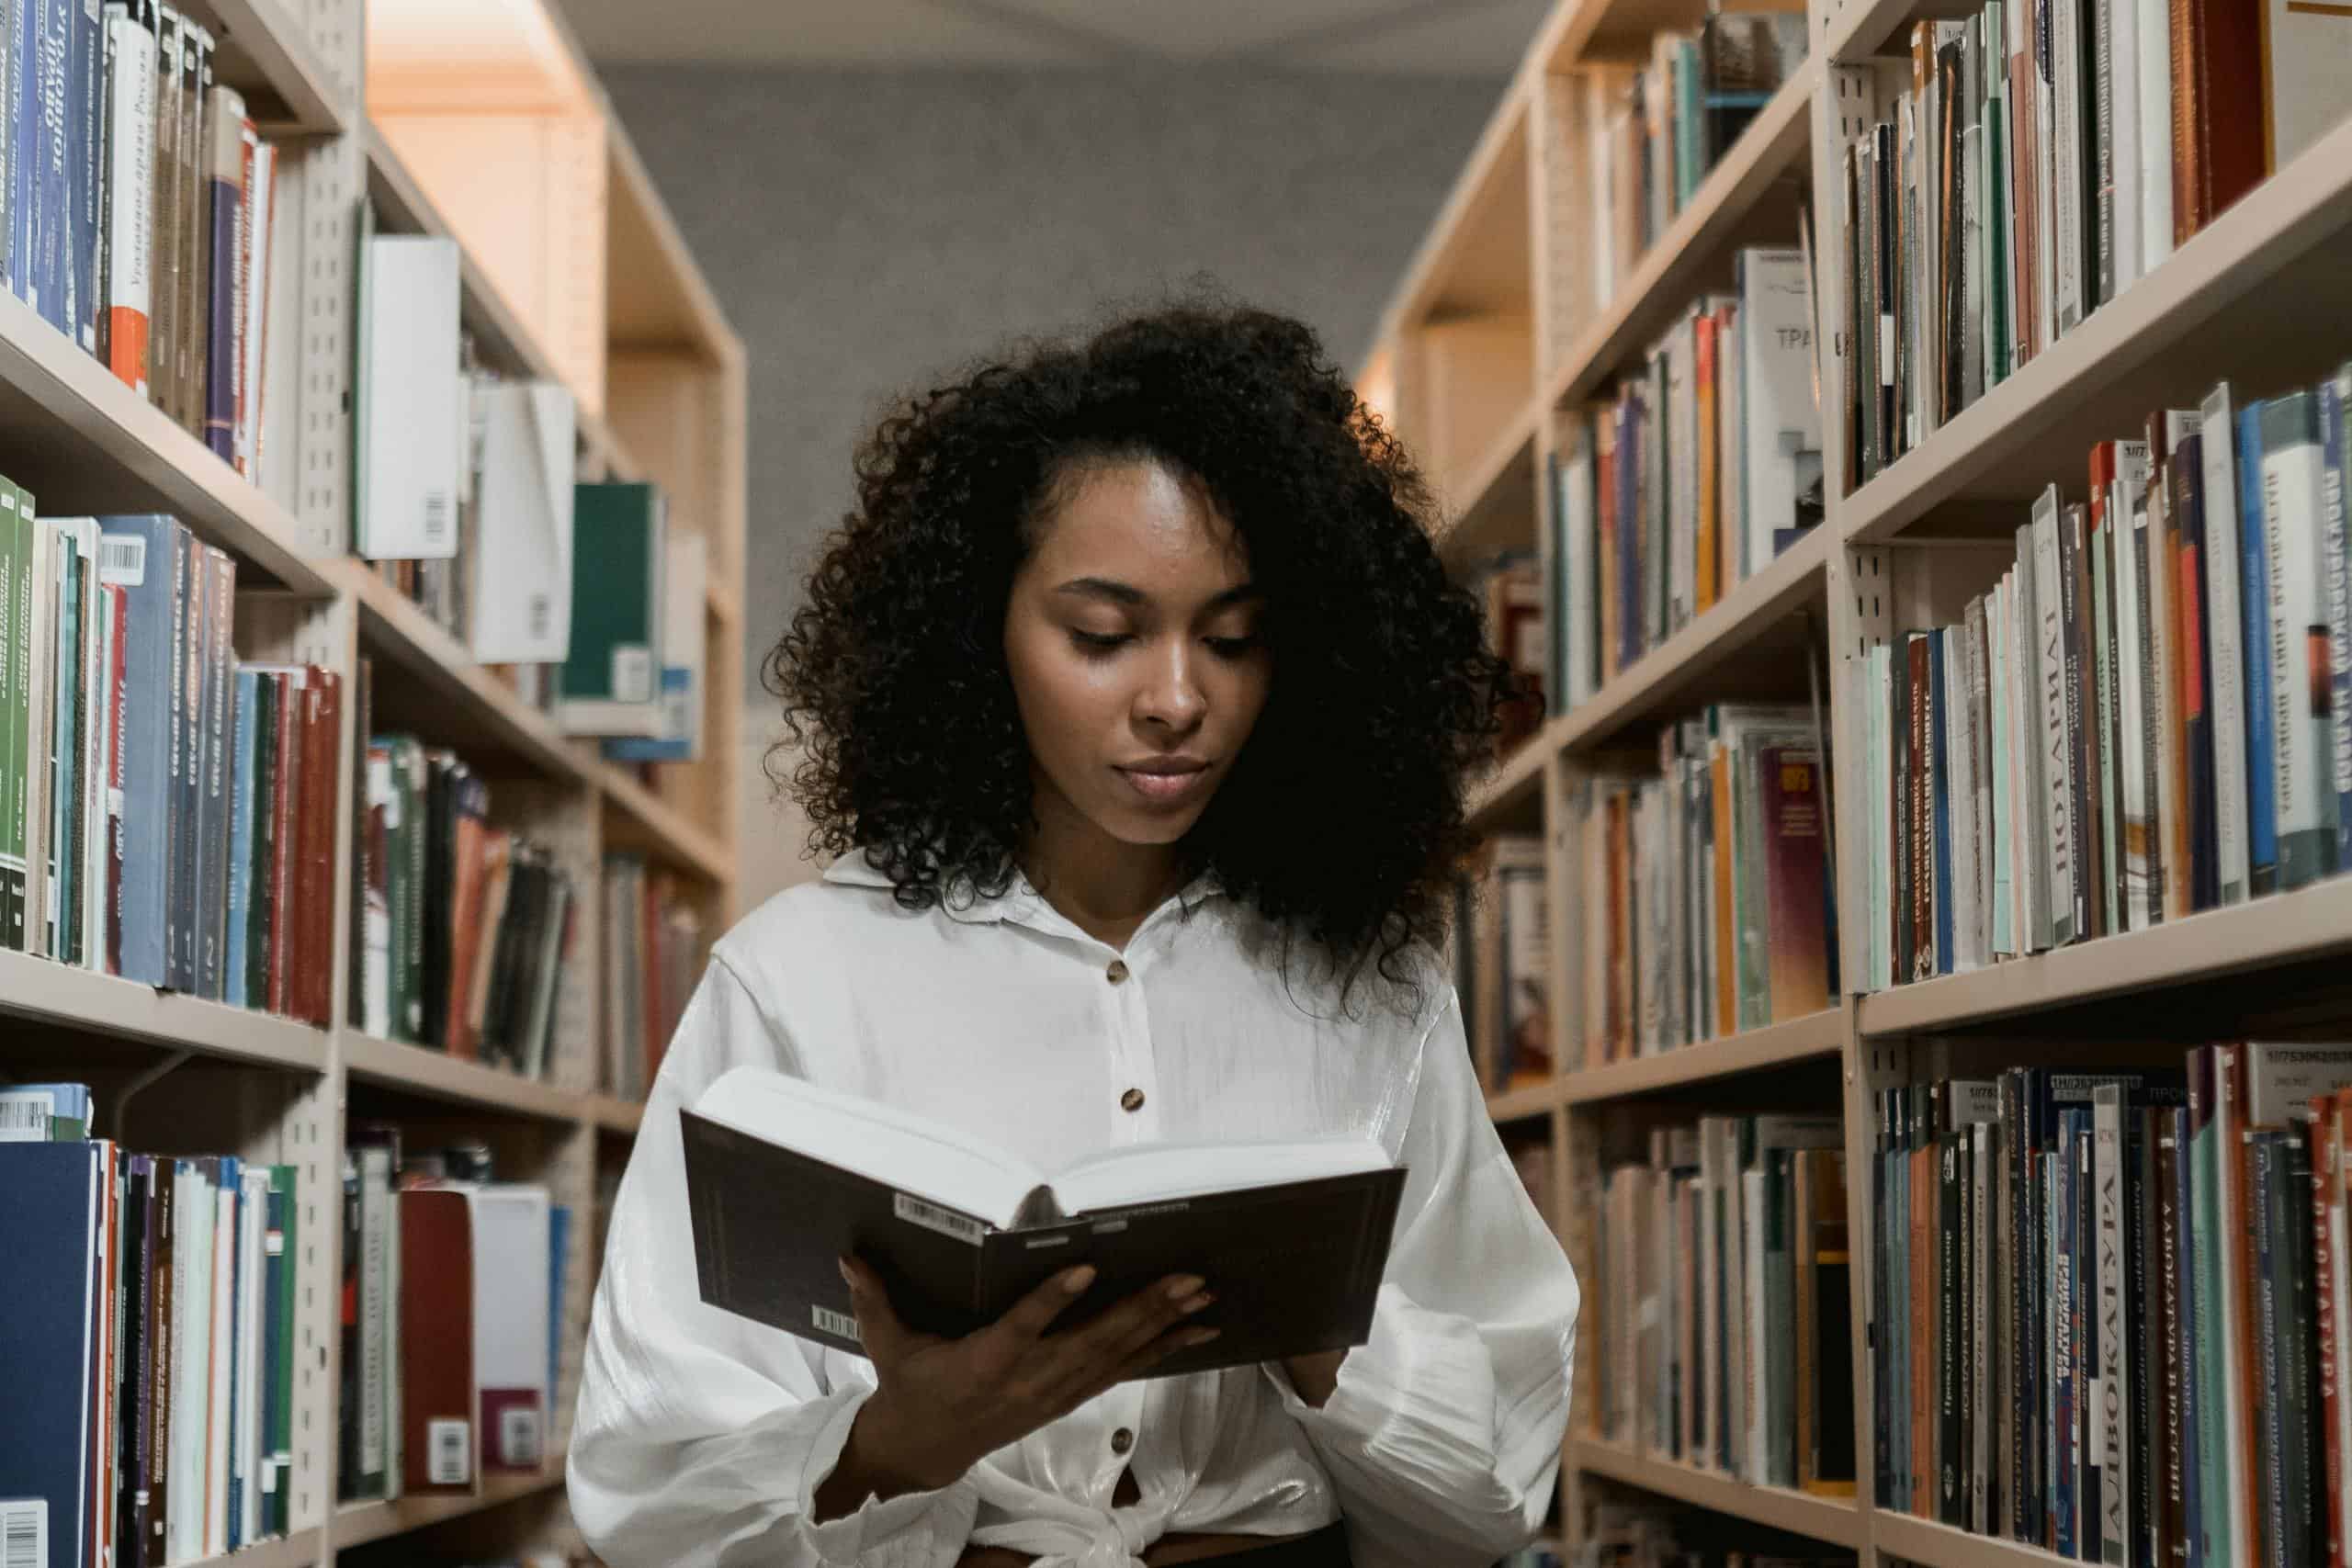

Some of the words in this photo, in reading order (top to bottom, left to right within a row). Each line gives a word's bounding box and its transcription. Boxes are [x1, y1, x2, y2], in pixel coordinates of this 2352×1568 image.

[45, 35, 58, 129] ПРАВО
[51, 5, 67, 175] УГОЛОВНОЕ
[2044, 611, 2067, 875] НОТАРИАТ
[1943, 1230, 1953, 1288] надзор
[2162, 1201, 2177, 1366] АДВОКАТУРА
[2312, 1176, 2335, 1398] АДВОКАТУРА
[1943, 1292, 1953, 1416] Прокурорский
[2102, 1175, 2120, 1529] АДВОКАТУРА
[2166, 1372, 2177, 1388] В
[2167, 1393, 2181, 1505] РОССИИ
